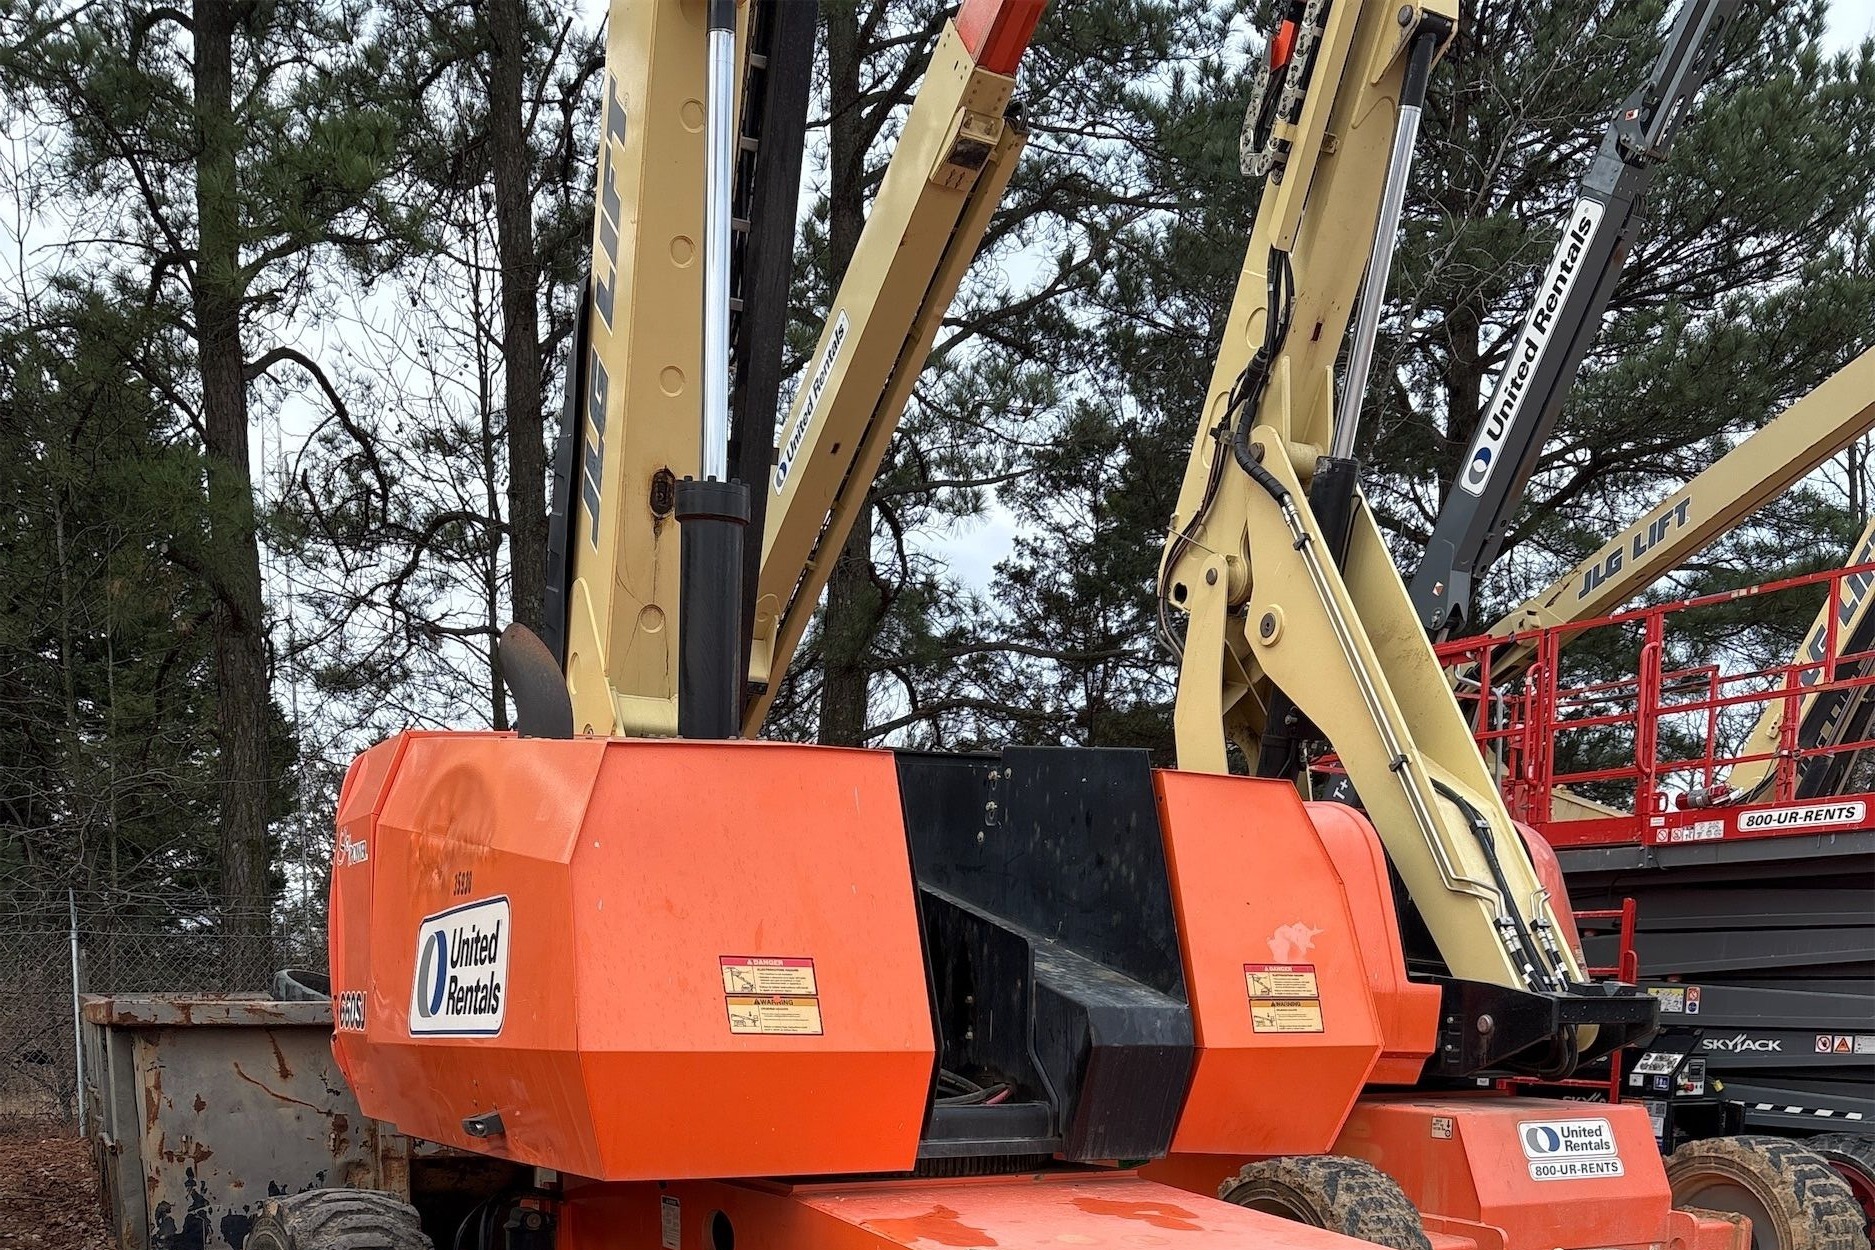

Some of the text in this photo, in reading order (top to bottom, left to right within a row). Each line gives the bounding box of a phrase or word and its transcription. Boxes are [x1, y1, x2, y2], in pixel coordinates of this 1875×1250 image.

[581, 73, 627, 557] JLG LIFT
[1486, 215, 1592, 443] United Rentals
[786, 323, 846, 463] United Rentals
[1577, 496, 1691, 601] JLG LIFT
[1745, 805, 1856, 828] 800-UR-RENTS
[449, 918, 501, 970] United
[444, 970, 501, 1016] Rentals
[1702, 1033, 1783, 1053] SKYJACK
[1560, 1125, 1603, 1139] United
[1564, 1139, 1611, 1152] Rentals
[1535, 1162, 1619, 1176] 800-UR-RENTS
